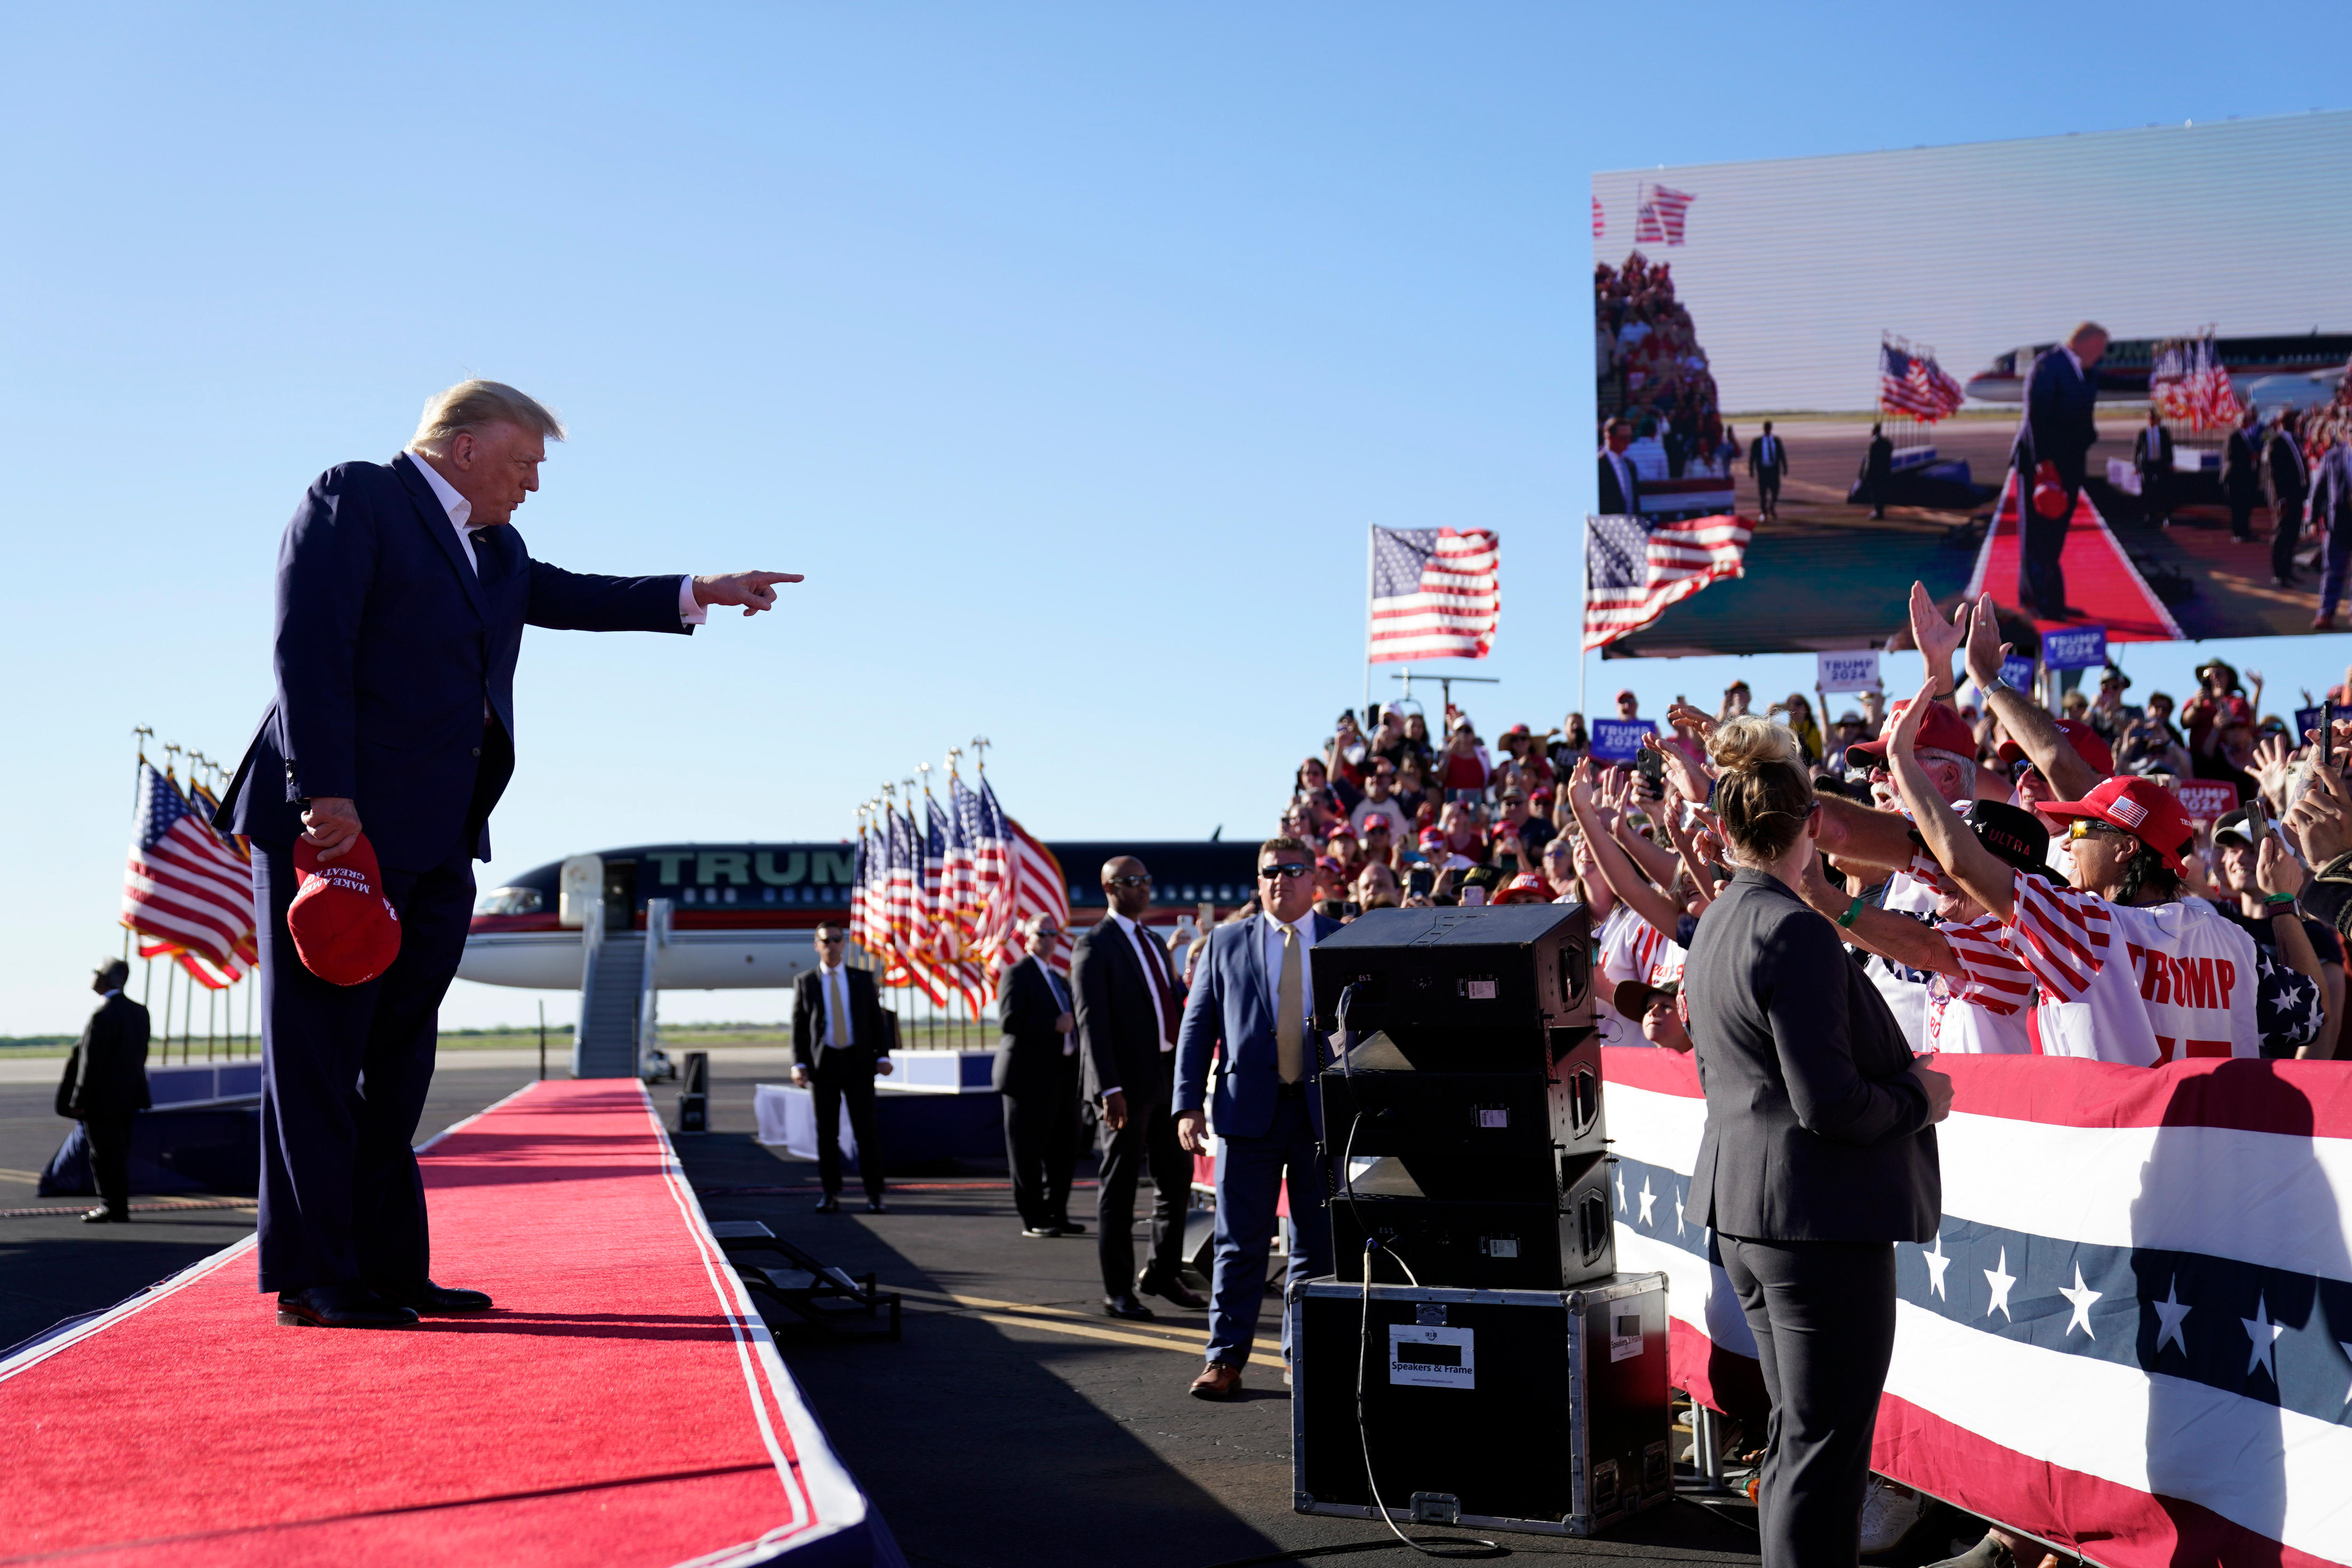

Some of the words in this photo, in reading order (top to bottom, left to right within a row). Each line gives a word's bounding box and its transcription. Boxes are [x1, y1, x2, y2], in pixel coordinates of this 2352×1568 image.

[2048, 633, 2100, 649] TRUMP
[2057, 643, 2094, 658] 2024
[1824, 659, 1873, 669] TRUMP
[1831, 668, 1866, 681] 2024
[1598, 724, 1650, 737] TRUMP
[1605, 734, 1642, 748] 2024
[2179, 787, 2230, 799] RUMP
[2185, 799, 2223, 812] 024
[1988, 828, 2030, 856] ULTRA
[324, 868, 365, 881] GREAT
[646, 851, 854, 885] TRUM
[333, 877, 370, 894] MAKE
[2126, 941, 2235, 1010] TRUMP
[1392, 1361, 1431, 1372] Speakers
[1434, 1364, 1442, 1372] &
[1445, 1365, 1473, 1375] Frame
